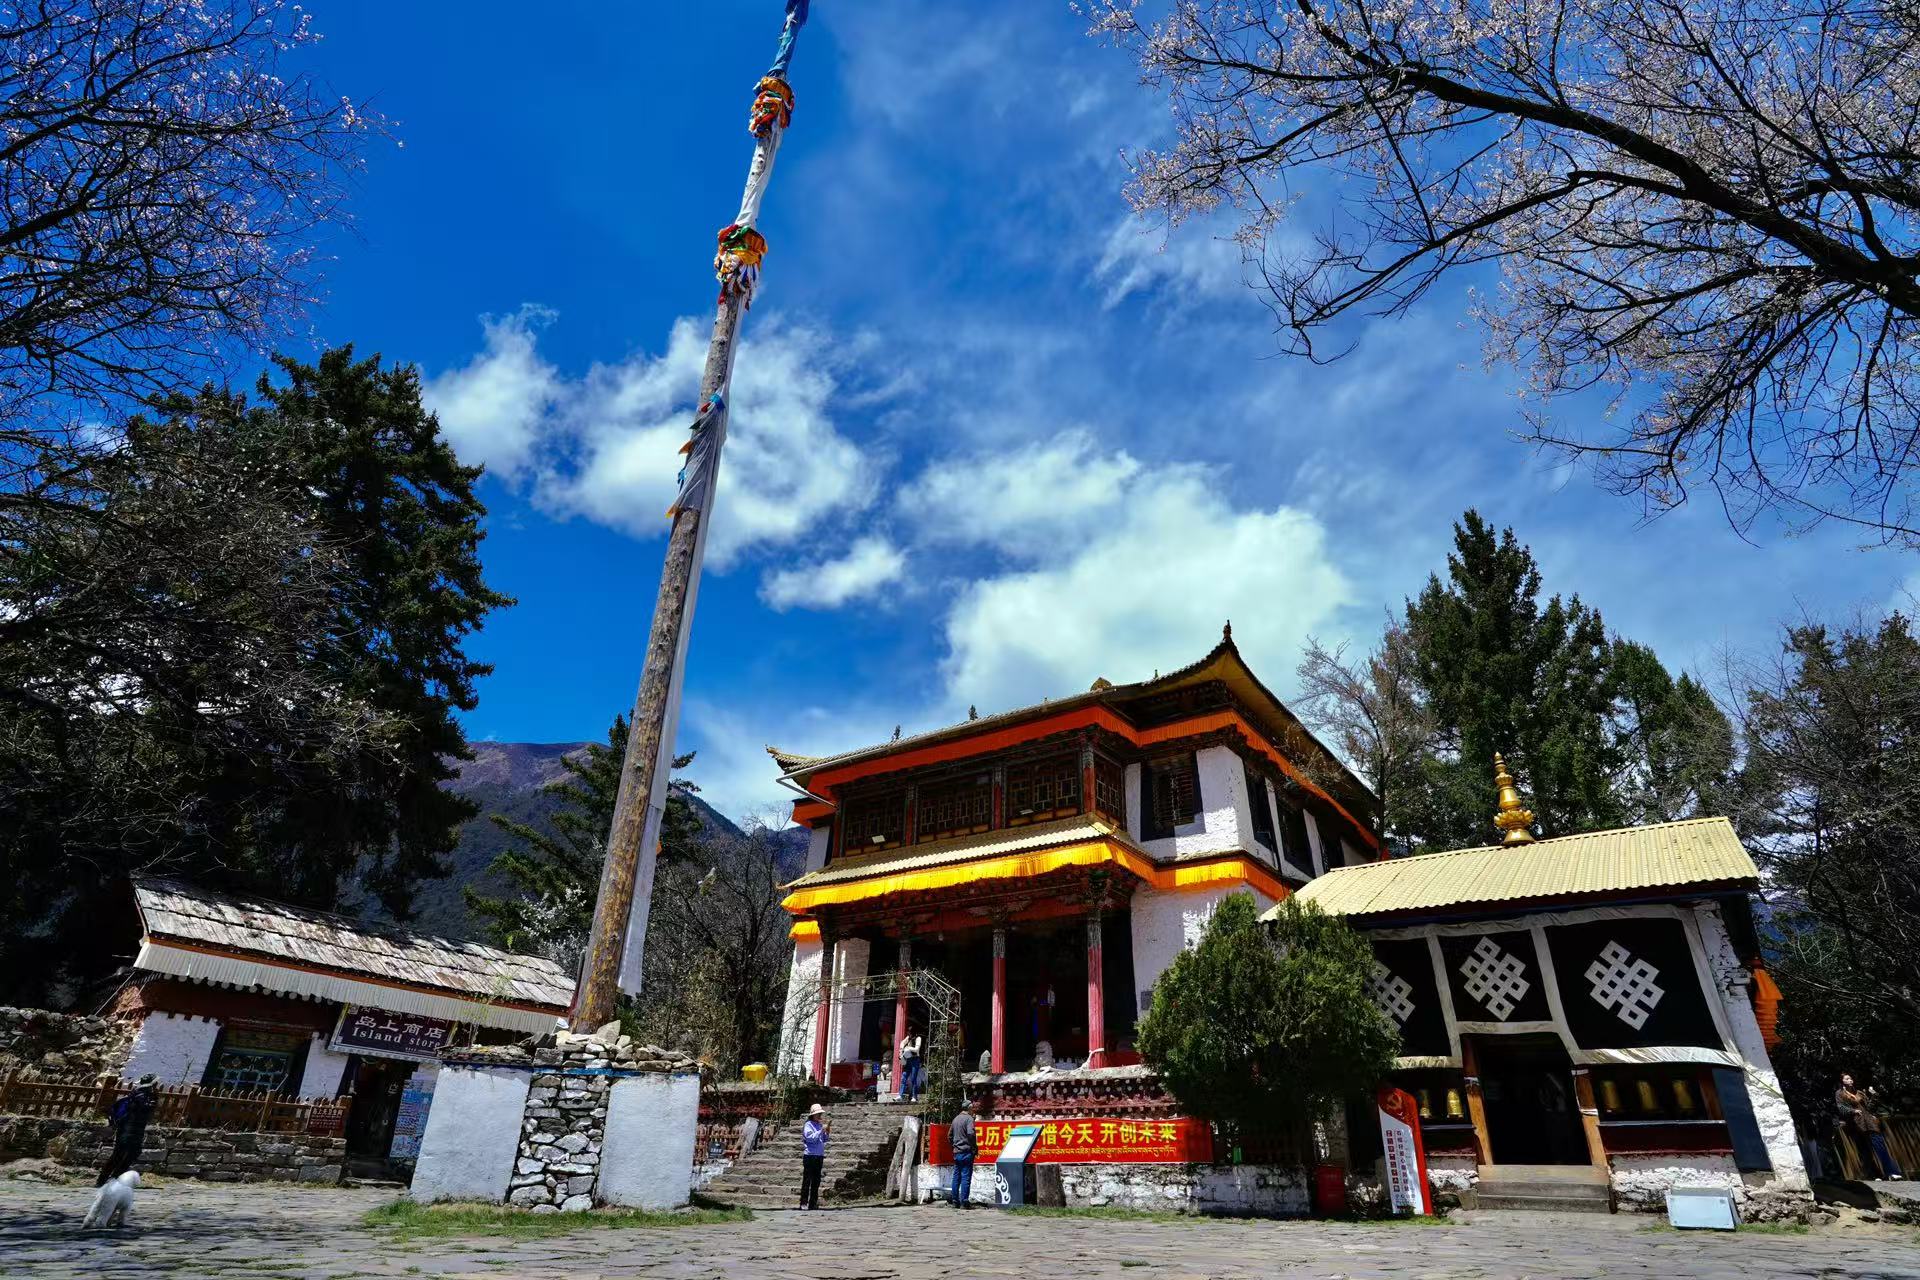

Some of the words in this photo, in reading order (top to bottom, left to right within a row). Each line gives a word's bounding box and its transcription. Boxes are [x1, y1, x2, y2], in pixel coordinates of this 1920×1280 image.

[352, 1026, 402, 1043] Island
[409, 1036, 441, 1048] store
[355, 1015, 446, 1039] 岛上商店
[1100, 1121, 1177, 1144] 开创未来
